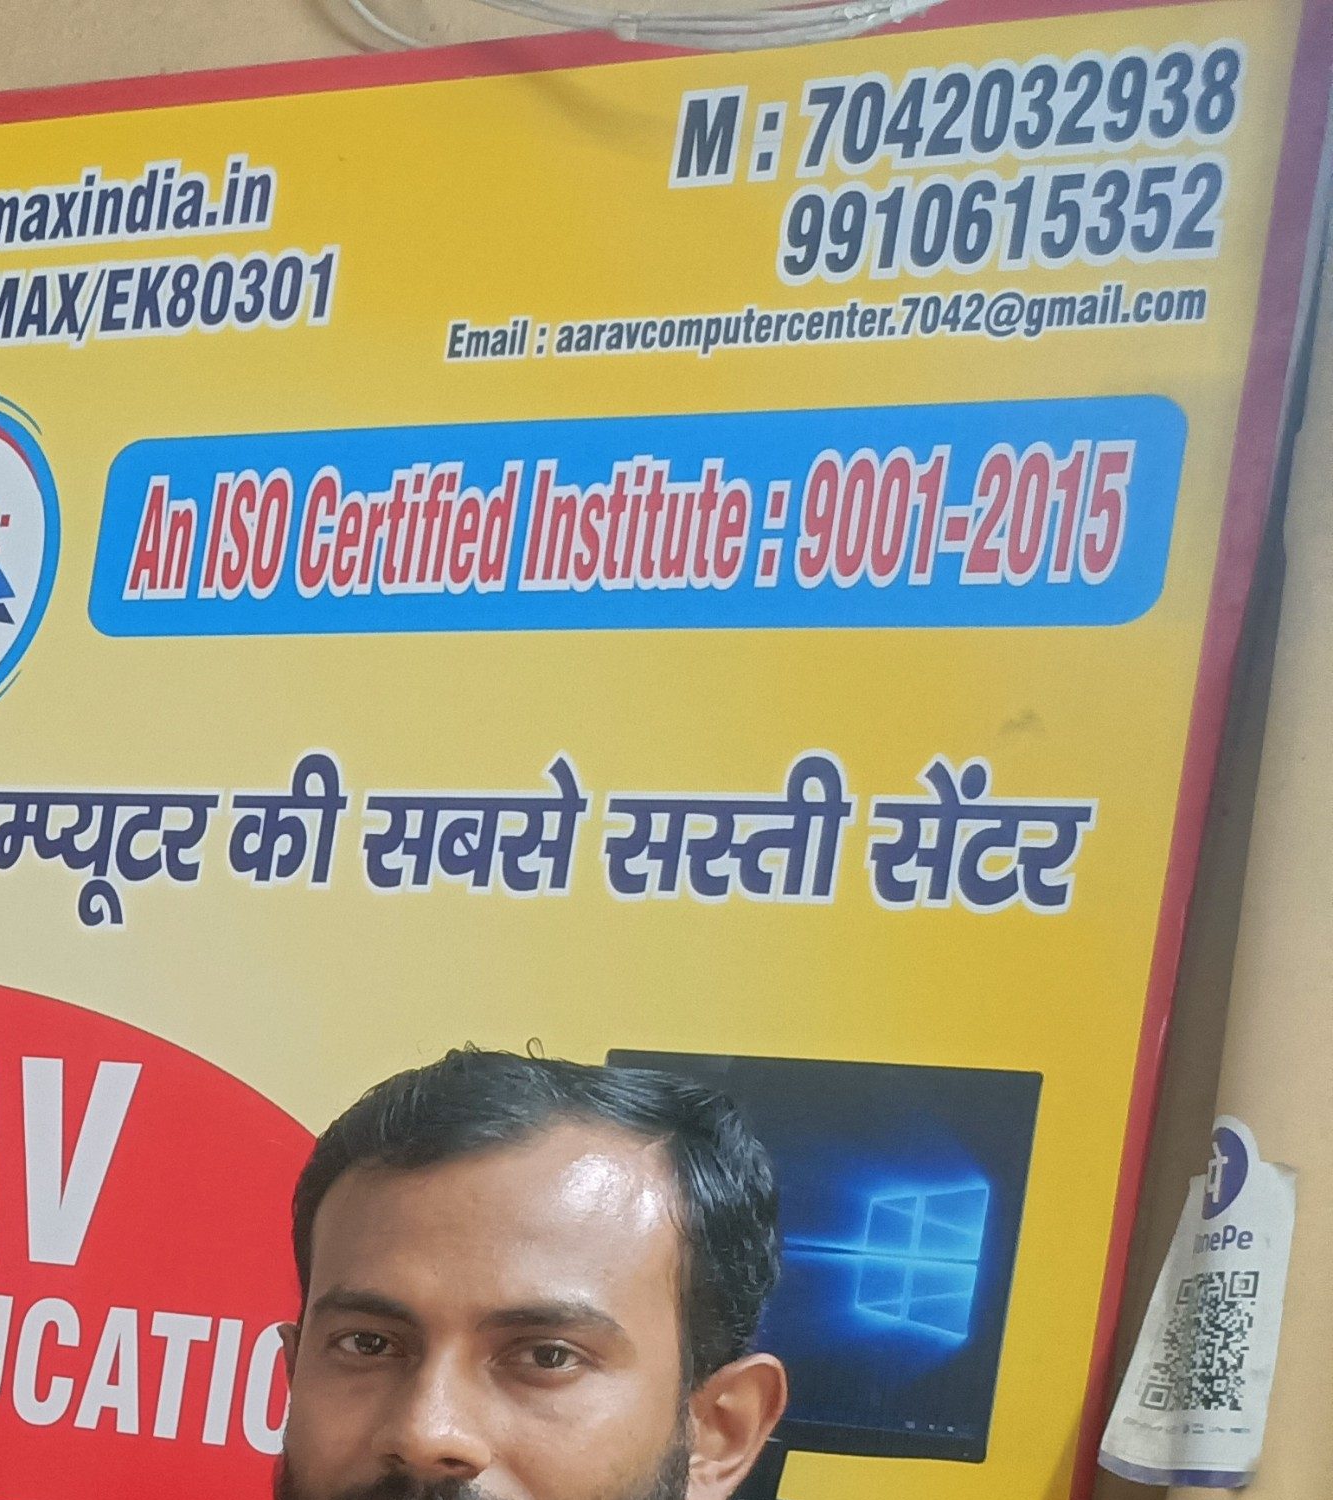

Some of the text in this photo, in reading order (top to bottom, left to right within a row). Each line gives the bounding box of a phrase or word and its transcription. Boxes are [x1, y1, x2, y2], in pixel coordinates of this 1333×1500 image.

[676, 47, 1240, 179] M : 7042032938
[783, 162, 1225, 276] 9910615352
[447, 322, 526, 358] Email
[556, 287, 1205, 354] aaravcomputercenter.7042@gmail.com
[129, 445, 1131, 592] An ISO Certified Institute : 9001-2015
[229, 753, 346, 883] की
[363, 756, 588, 891] सबसे
[605, 754, 851, 898] सस्ती
[870, 759, 1091, 908] सेंटर
